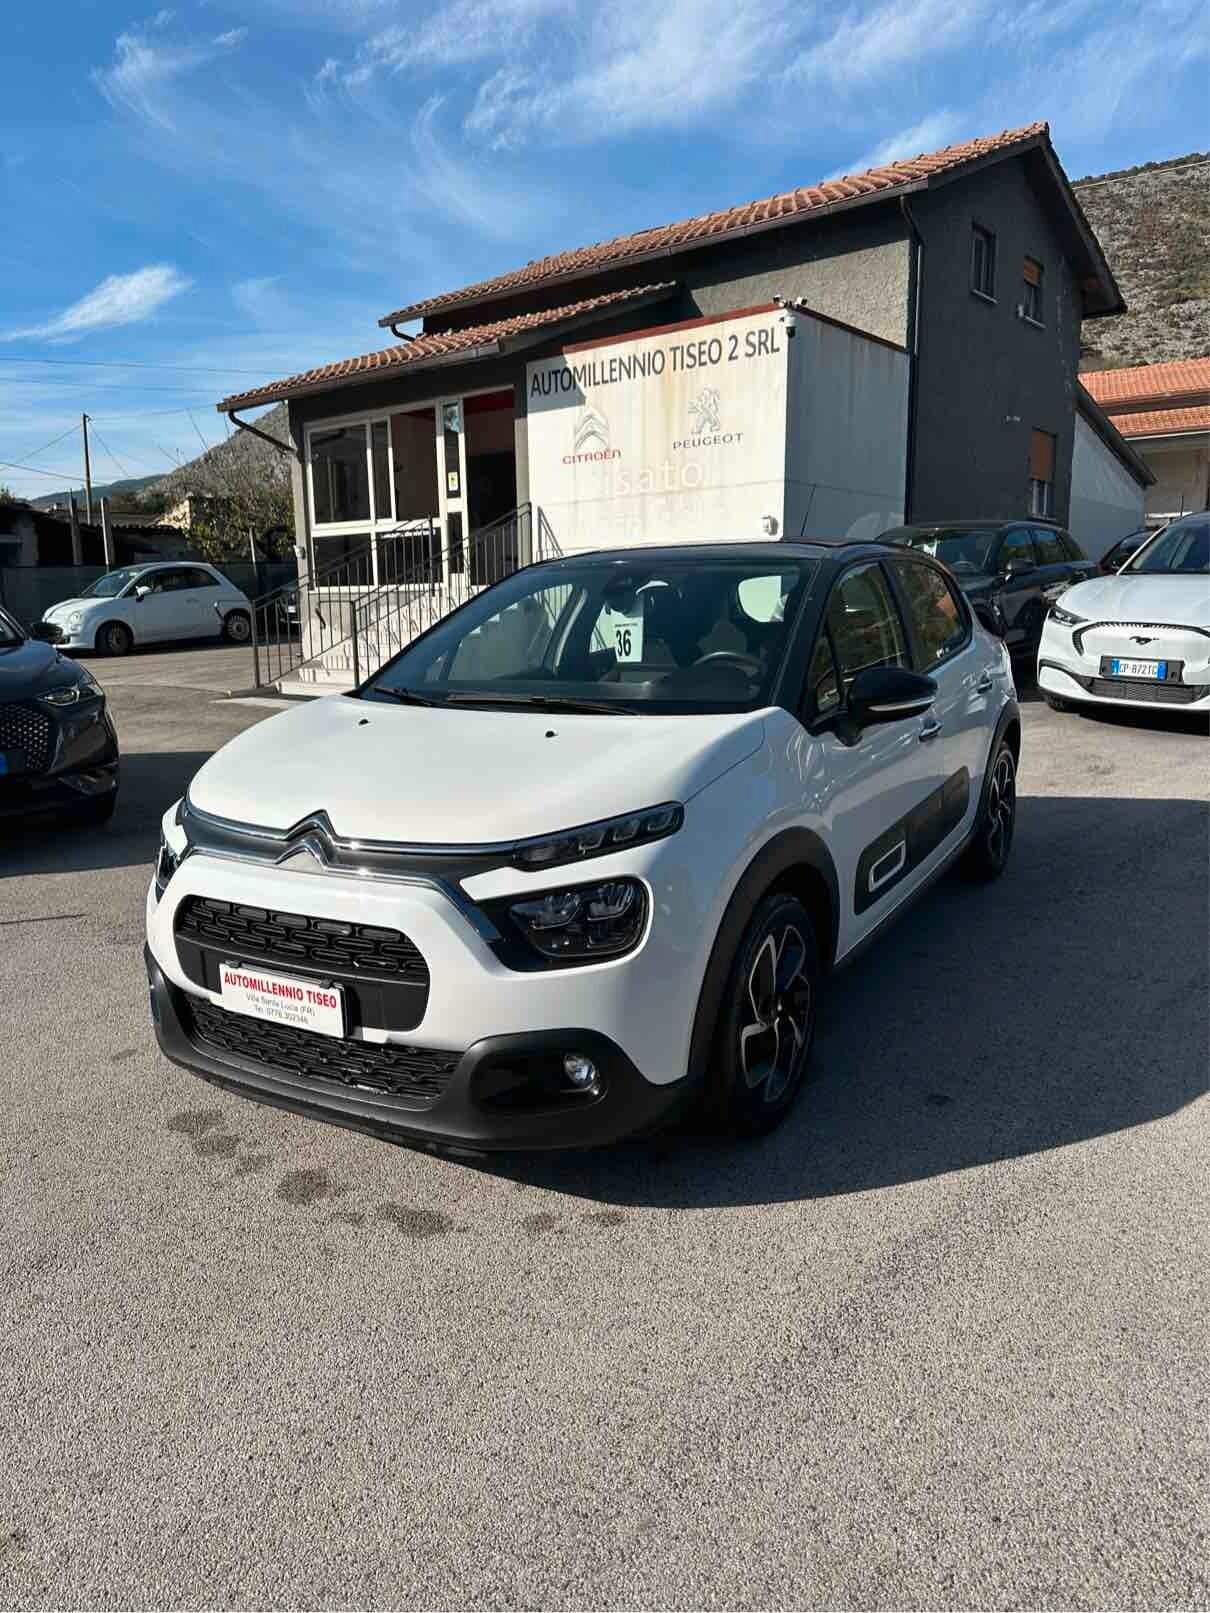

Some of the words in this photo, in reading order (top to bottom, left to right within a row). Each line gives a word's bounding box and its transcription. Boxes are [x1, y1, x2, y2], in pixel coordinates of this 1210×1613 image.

[530, 349, 666, 398] AUTOMILLENNIO
[670, 337, 723, 372] TISEO
[727, 334, 739, 362] 2
[744, 326, 780, 358] SRL
[672, 432, 744, 450] PEUGEOT
[562, 448, 622, 465] CITROËN
[615, 629, 632, 657] 36
[224, 971, 304, 1001] AUTOMILLENNIO
[306, 990, 337, 1009] TISEO
